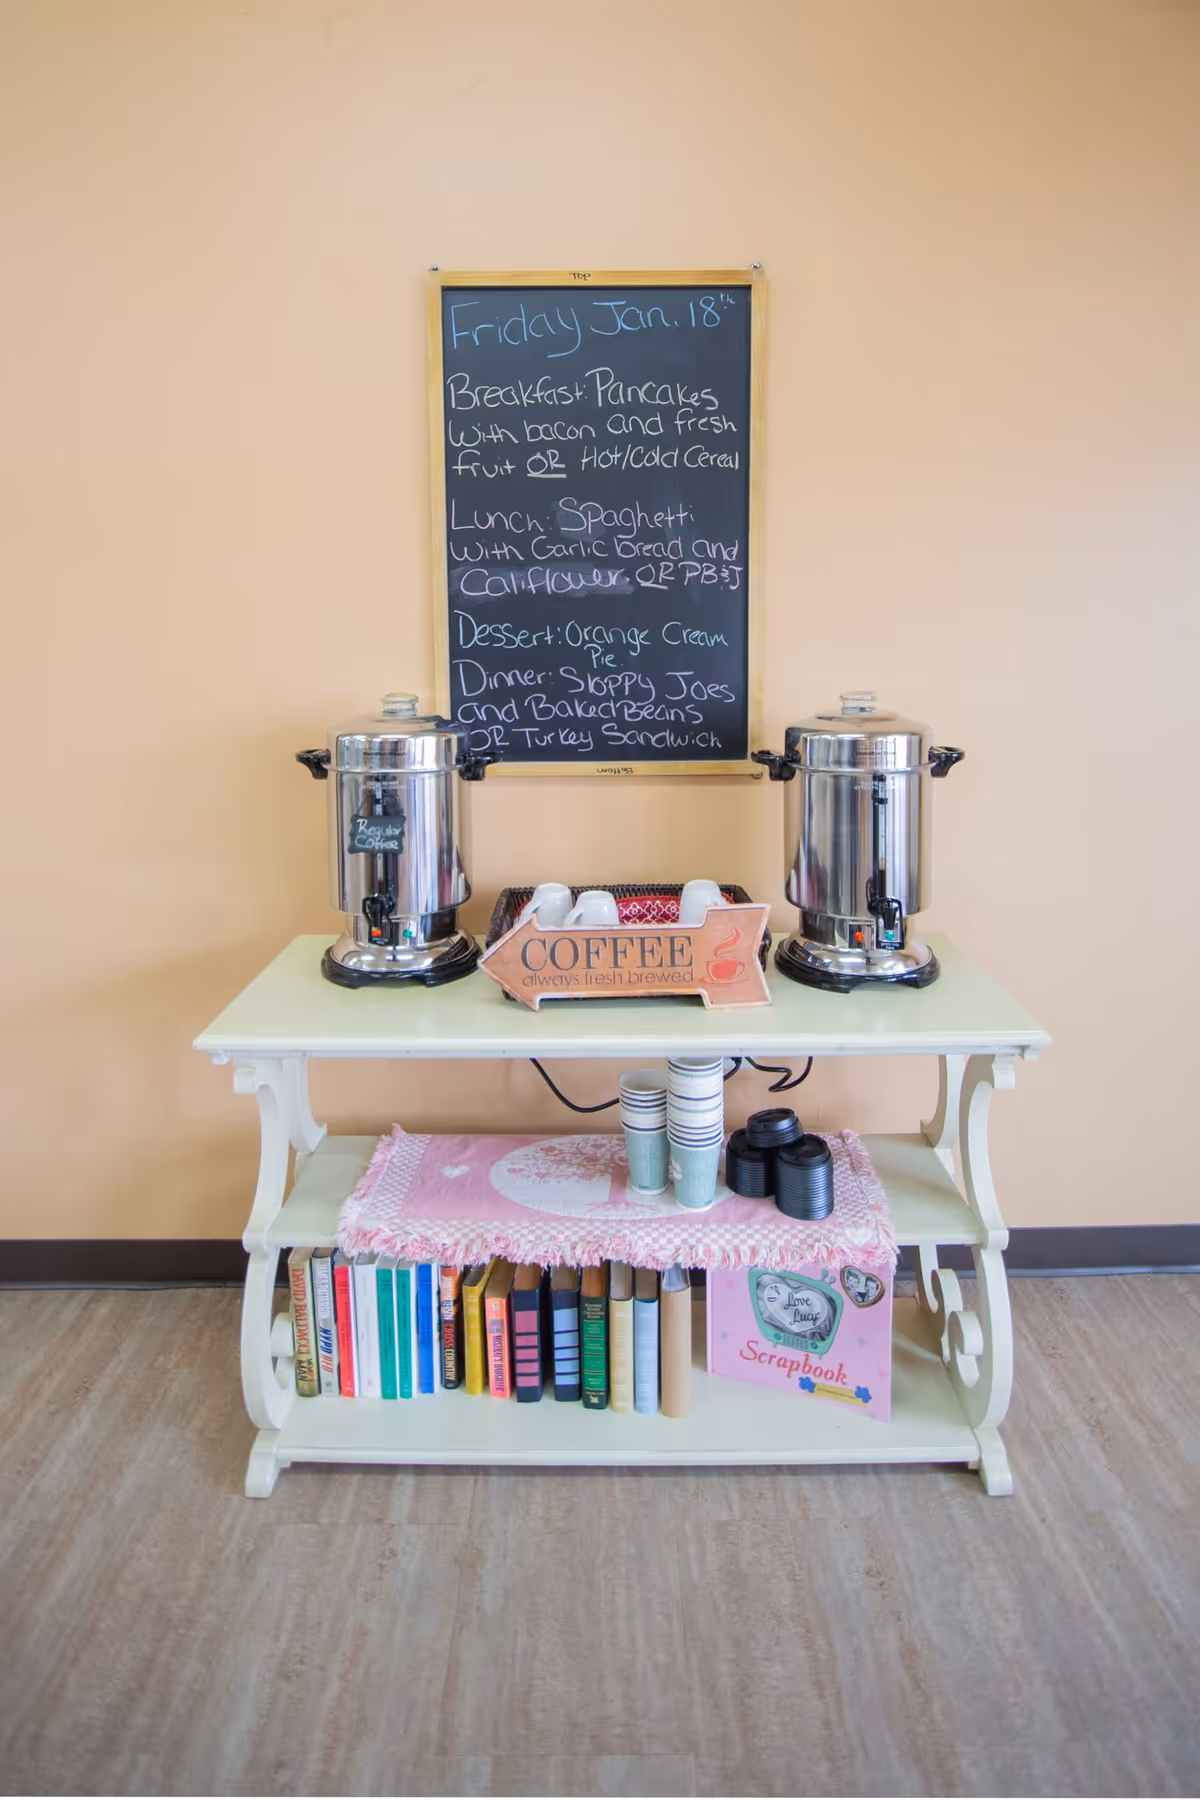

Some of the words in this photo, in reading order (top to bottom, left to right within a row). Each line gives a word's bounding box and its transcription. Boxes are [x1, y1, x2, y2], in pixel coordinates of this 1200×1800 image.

[450, 301, 582, 358] Friday
[590, 300, 680, 336] Jan.
[446, 372, 588, 410] Breakfast:
[584, 366, 719, 410] Pancakes
[523, 419, 597, 442] bacon
[606, 412, 664, 435] and
[674, 408, 738, 434] fresh
[451, 449, 517, 478] fruit
[526, 449, 567, 476] OR
[580, 443, 679, 471] Hot/Cold
[683, 445, 740, 470] Cereal
[451, 498, 553, 534] Lunch:
[531, 536, 609, 558] Garlic
[613, 536, 684, 558] bread
[691, 539, 739, 561] and
[635, 561, 676, 586] OR
[453, 609, 562, 649] Dessert:
[564, 620, 651, 656] Orange
[661, 621, 730, 647] Cream
[451, 658, 553, 697] Dinner:
[559, 665, 656, 705] Sloppy
[664, 671, 736, 703] Joes
[456, 699, 519, 724] and
[524, 693, 617, 722] Baked
[615, 700, 704, 724] Beans
[511, 727, 595, 752] Turkey
[600, 723, 724, 748] Sandwich
[354, 834, 400, 850] Coffee
[356, 818, 402, 839] Regular
[520, 935, 694, 972] COFFEE
[521, 969, 580, 988] always
[584, 968, 623, 986] fresh
[627, 967, 694, 985] brewed
[292, 1267, 306, 1302] DAVID
[784, 1291, 812, 1310] Love
[294, 1303, 311, 1356] BALDACCI
[789, 1308, 820, 1327] Lucy
[319, 1326, 333, 1355] NYPD
[443, 1322, 455, 1349] CROSS
[296, 1359, 308, 1382] MAN
[320, 1355, 334, 1374] RED
[444, 1349, 456, 1381] COUNTRY
[739, 1339, 848, 1386] Scrapbook
